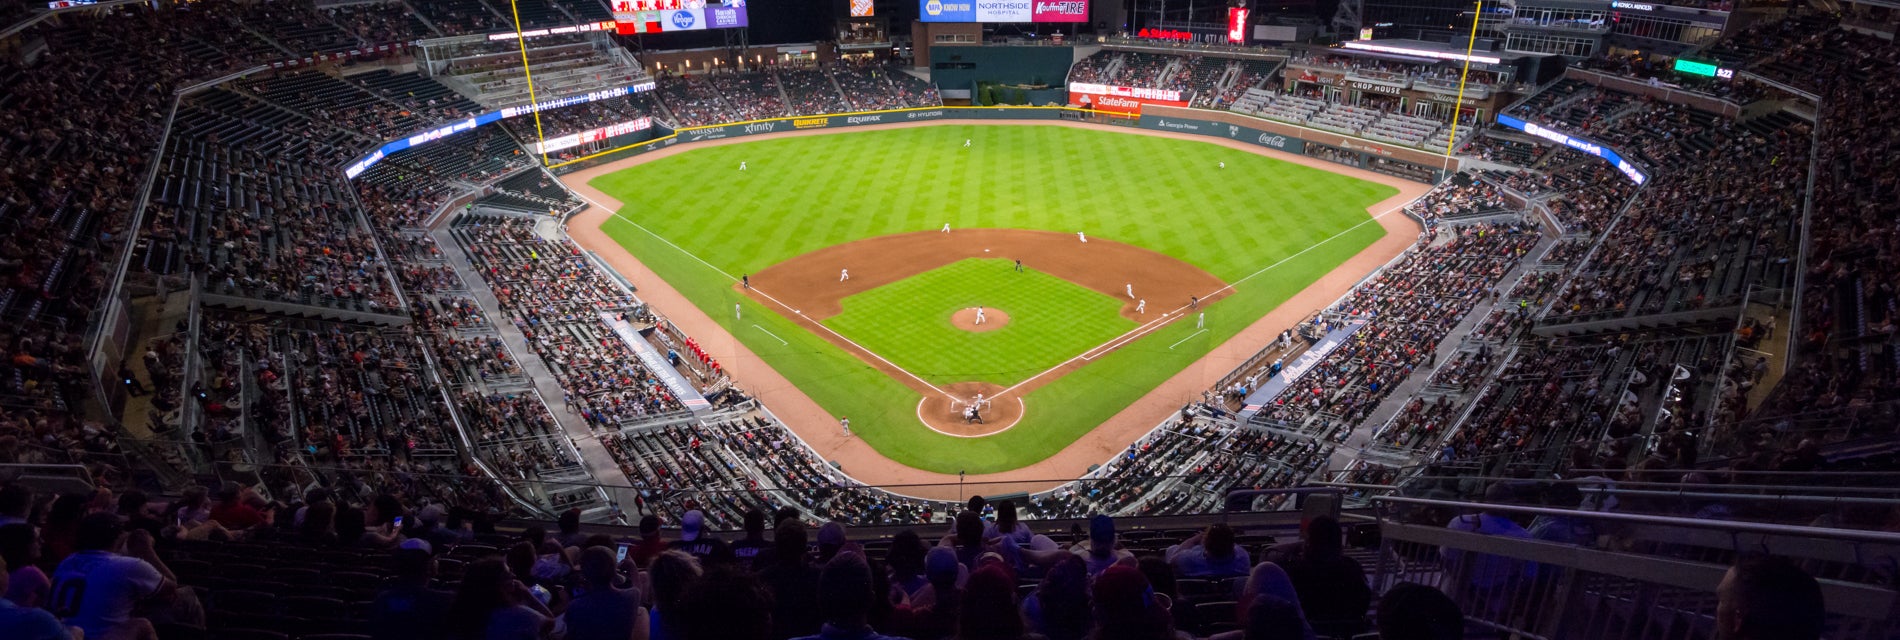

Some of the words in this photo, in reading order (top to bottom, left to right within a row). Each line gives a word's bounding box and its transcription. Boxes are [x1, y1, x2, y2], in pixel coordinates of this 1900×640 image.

[978, 2, 1030, 10] NORTHSIDE
[1059, 2, 1085, 15] TIRE
[673, 13, 694, 27] Kroger
[1716, 68, 1733, 79] 9:22
[1352, 82, 1373, 91] CHOP
[1374, 85, 1400, 95] HOUSE
[917, 110, 943, 118] HYUNDAI
[793, 117, 829, 127] QUIKRETE
[847, 115, 882, 124] EQUIFAX
[744, 122, 775, 134] xfinity
[1165, 121, 1184, 129] Georgia
[689, 126, 724, 136] WELLSTAR
